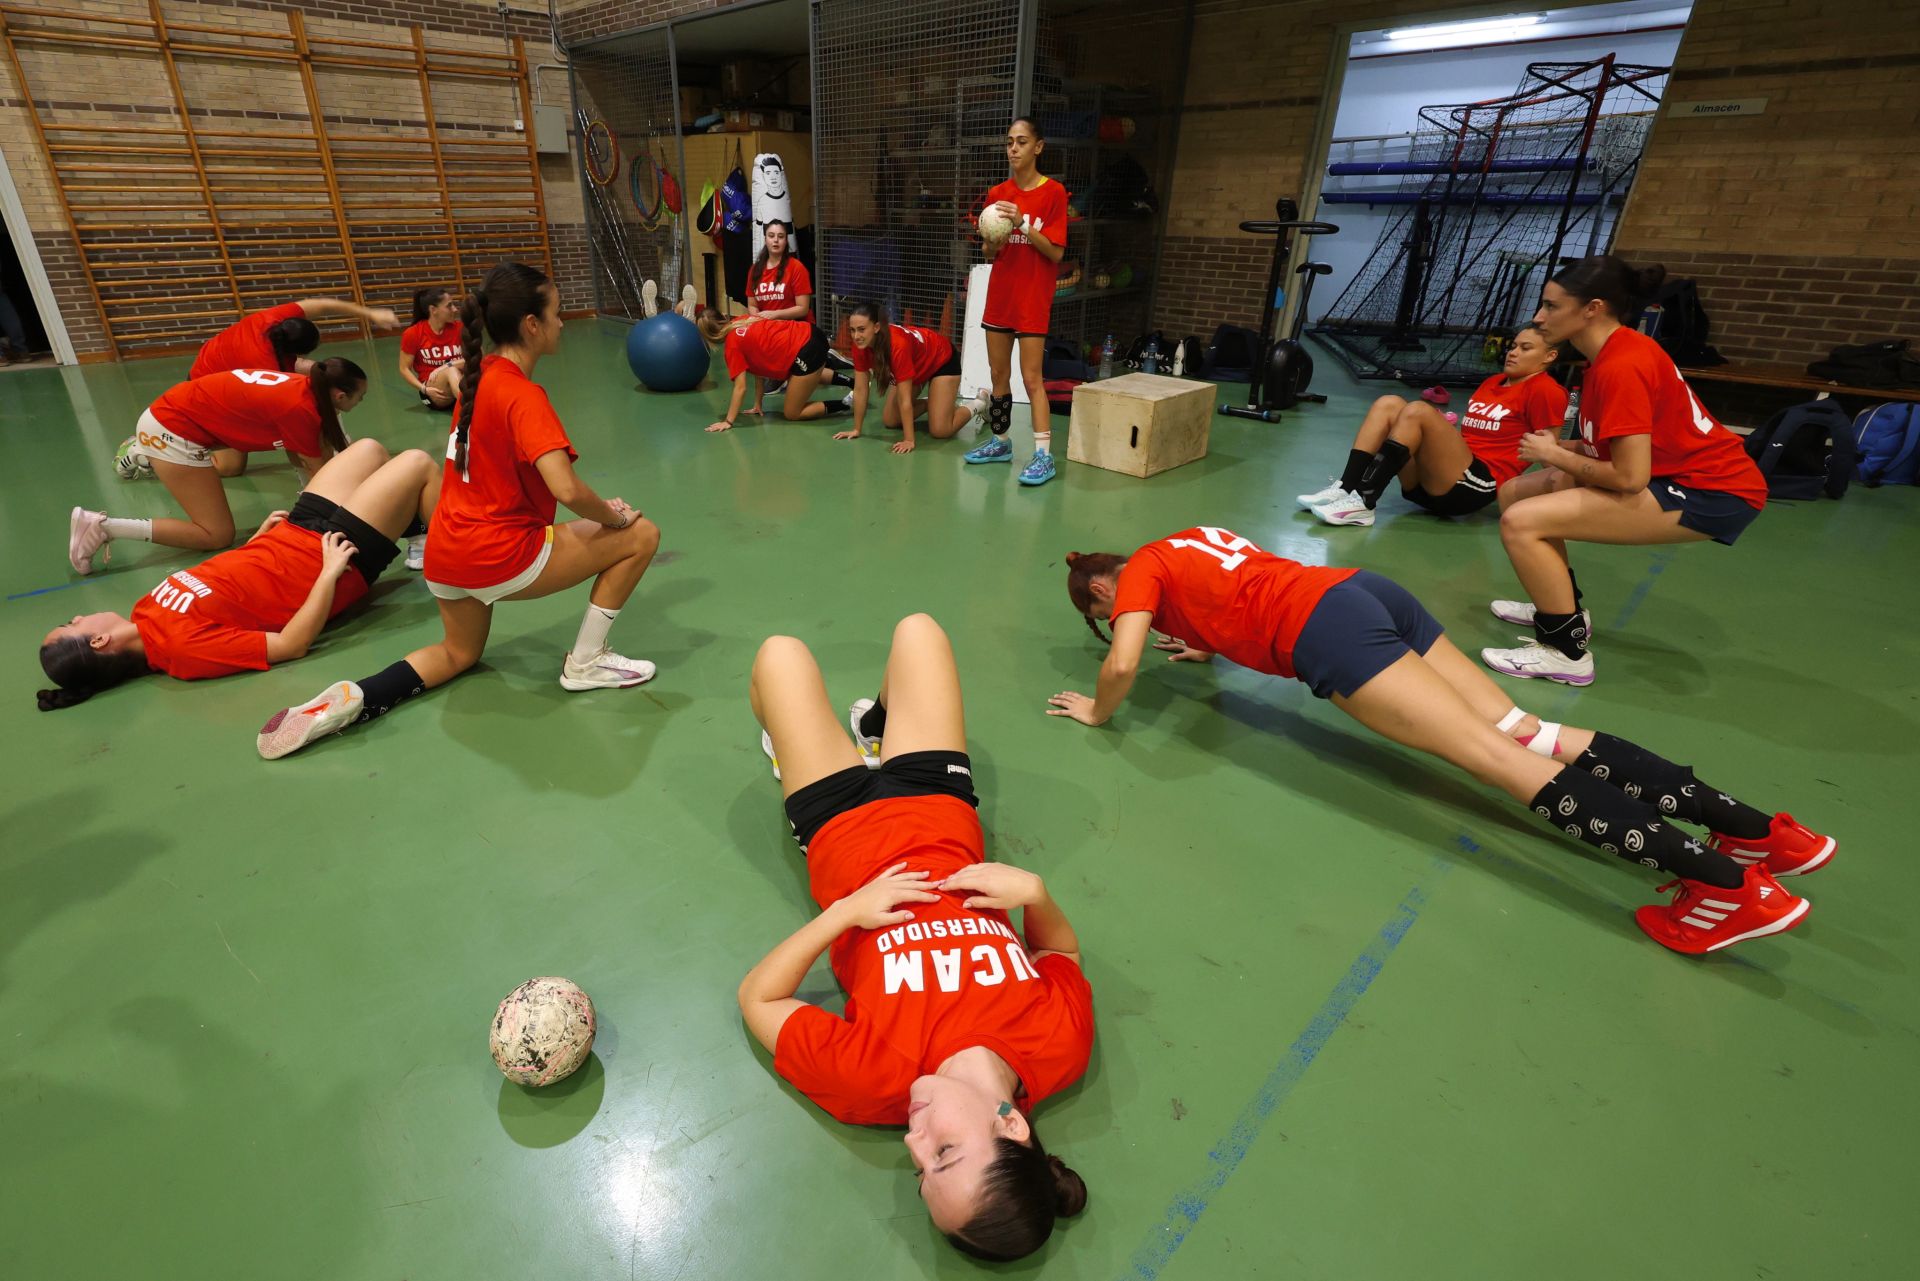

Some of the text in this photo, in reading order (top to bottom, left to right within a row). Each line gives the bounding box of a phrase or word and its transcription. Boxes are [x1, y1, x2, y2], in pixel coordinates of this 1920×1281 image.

[1461, 416, 1501, 431] VERSIDAD
[1468, 399, 1511, 421] CAM
[139, 431, 175, 450] GO fit
[1166, 526, 1262, 571] 14
[151, 579, 195, 614] UCA
[883, 942, 1041, 994] UCAM
